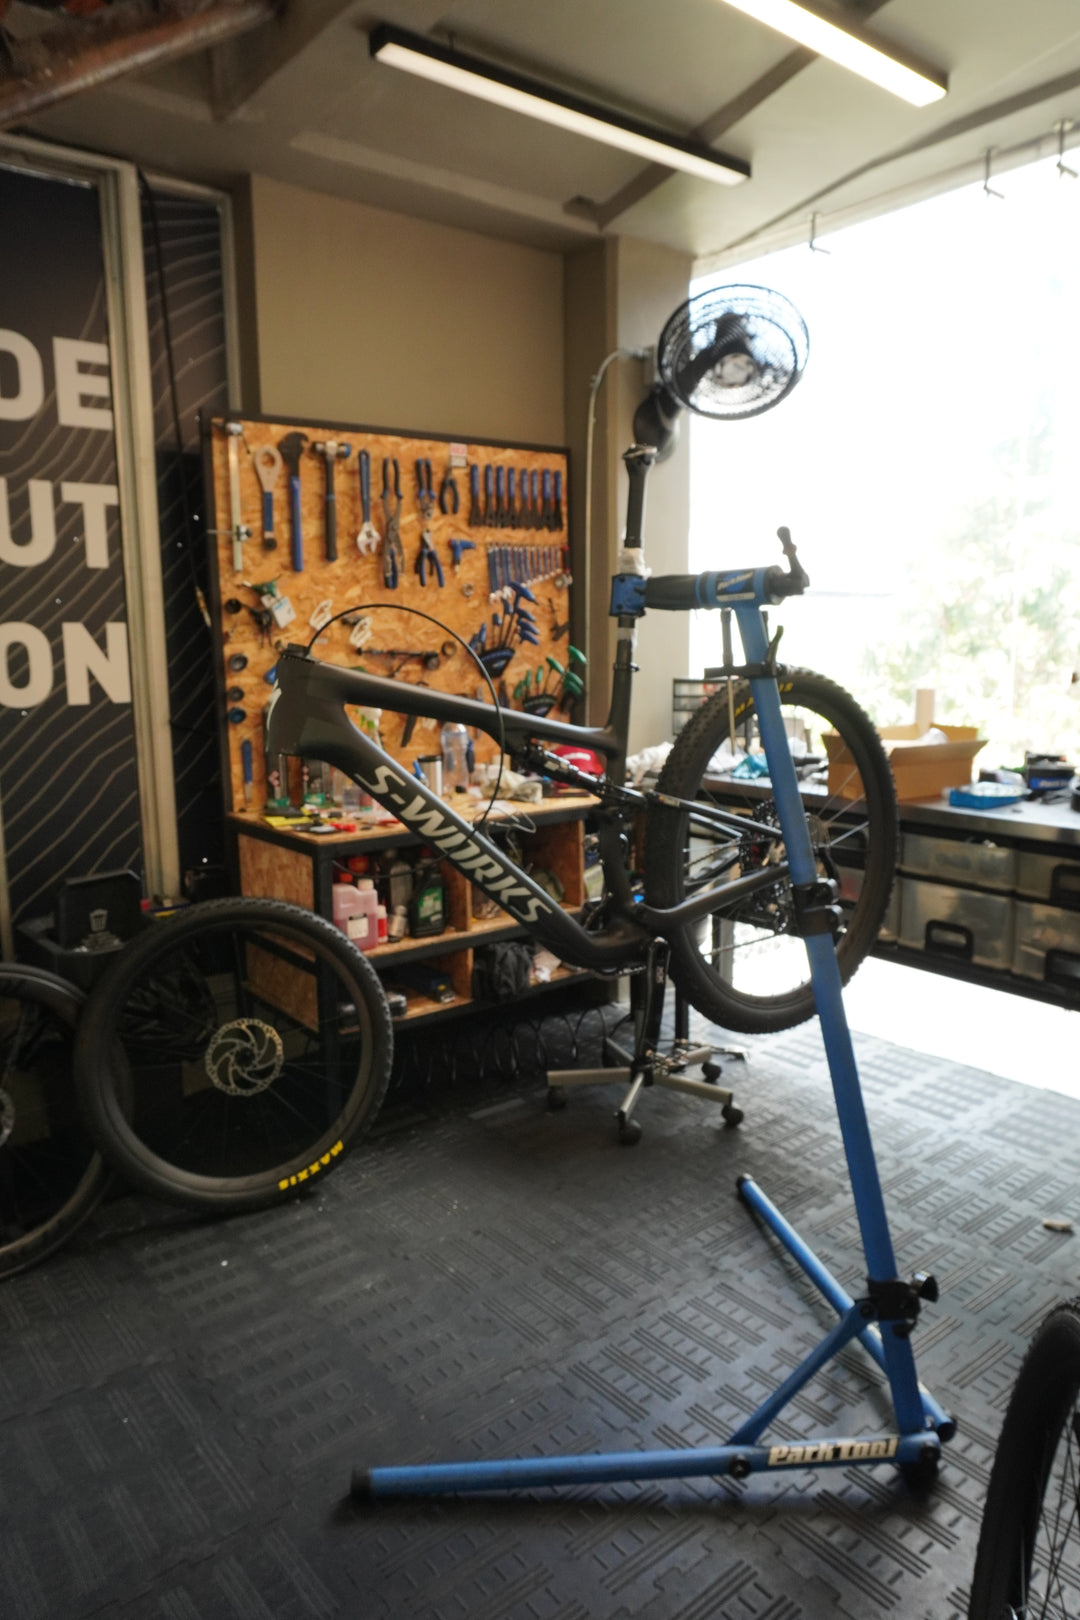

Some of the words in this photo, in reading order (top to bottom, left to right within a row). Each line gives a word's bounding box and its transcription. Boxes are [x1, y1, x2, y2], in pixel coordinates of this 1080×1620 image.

[0, 329, 114, 430] DE
[0, 477, 119, 568] UT
[0, 621, 132, 709] ON
[353, 765, 553, 923] S-WORKS
